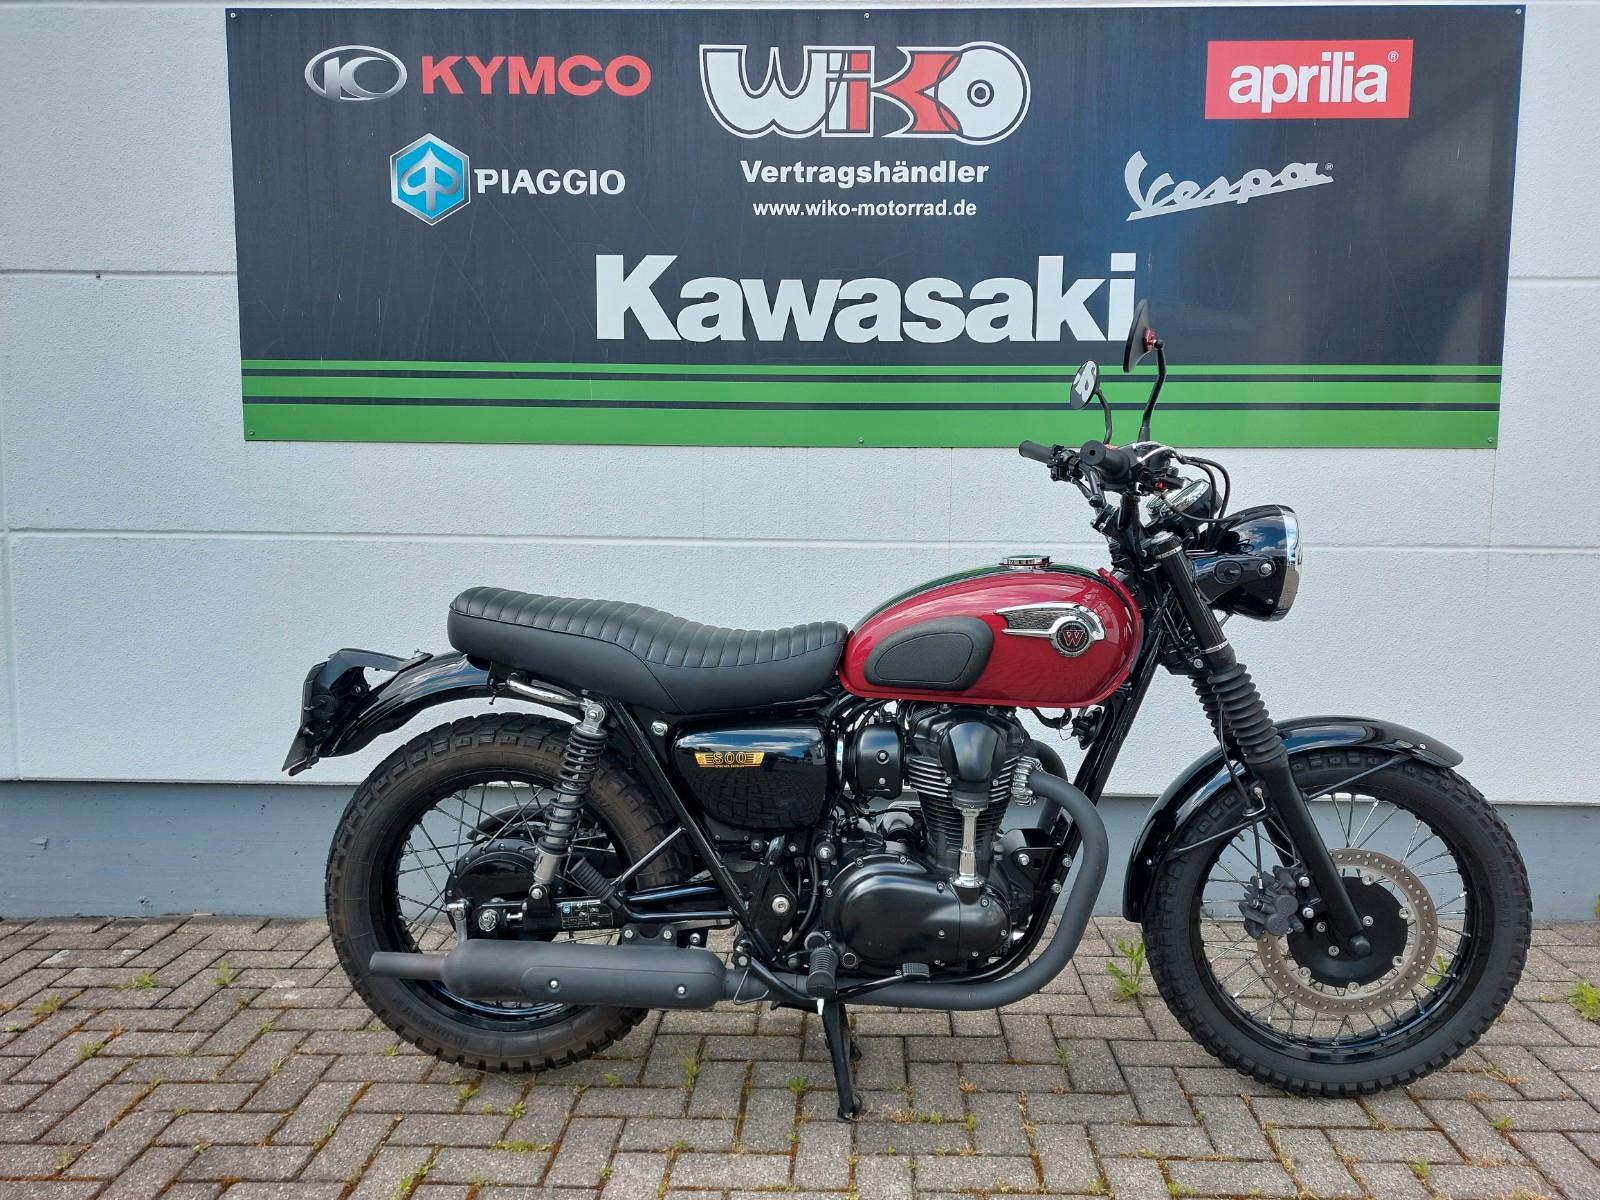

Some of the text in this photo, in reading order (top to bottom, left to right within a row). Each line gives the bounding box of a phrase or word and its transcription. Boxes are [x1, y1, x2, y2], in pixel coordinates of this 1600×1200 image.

[422, 55, 651, 97] KYMCO
[474, 168, 626, 195] PIAGGIO
[740, 160, 989, 189] Vertragshändler
[1124, 150, 1334, 222] Vespa
[752, 199, 977, 217] www.wiko-motorrad.de
[595, 252, 1137, 343] Kawasaki
